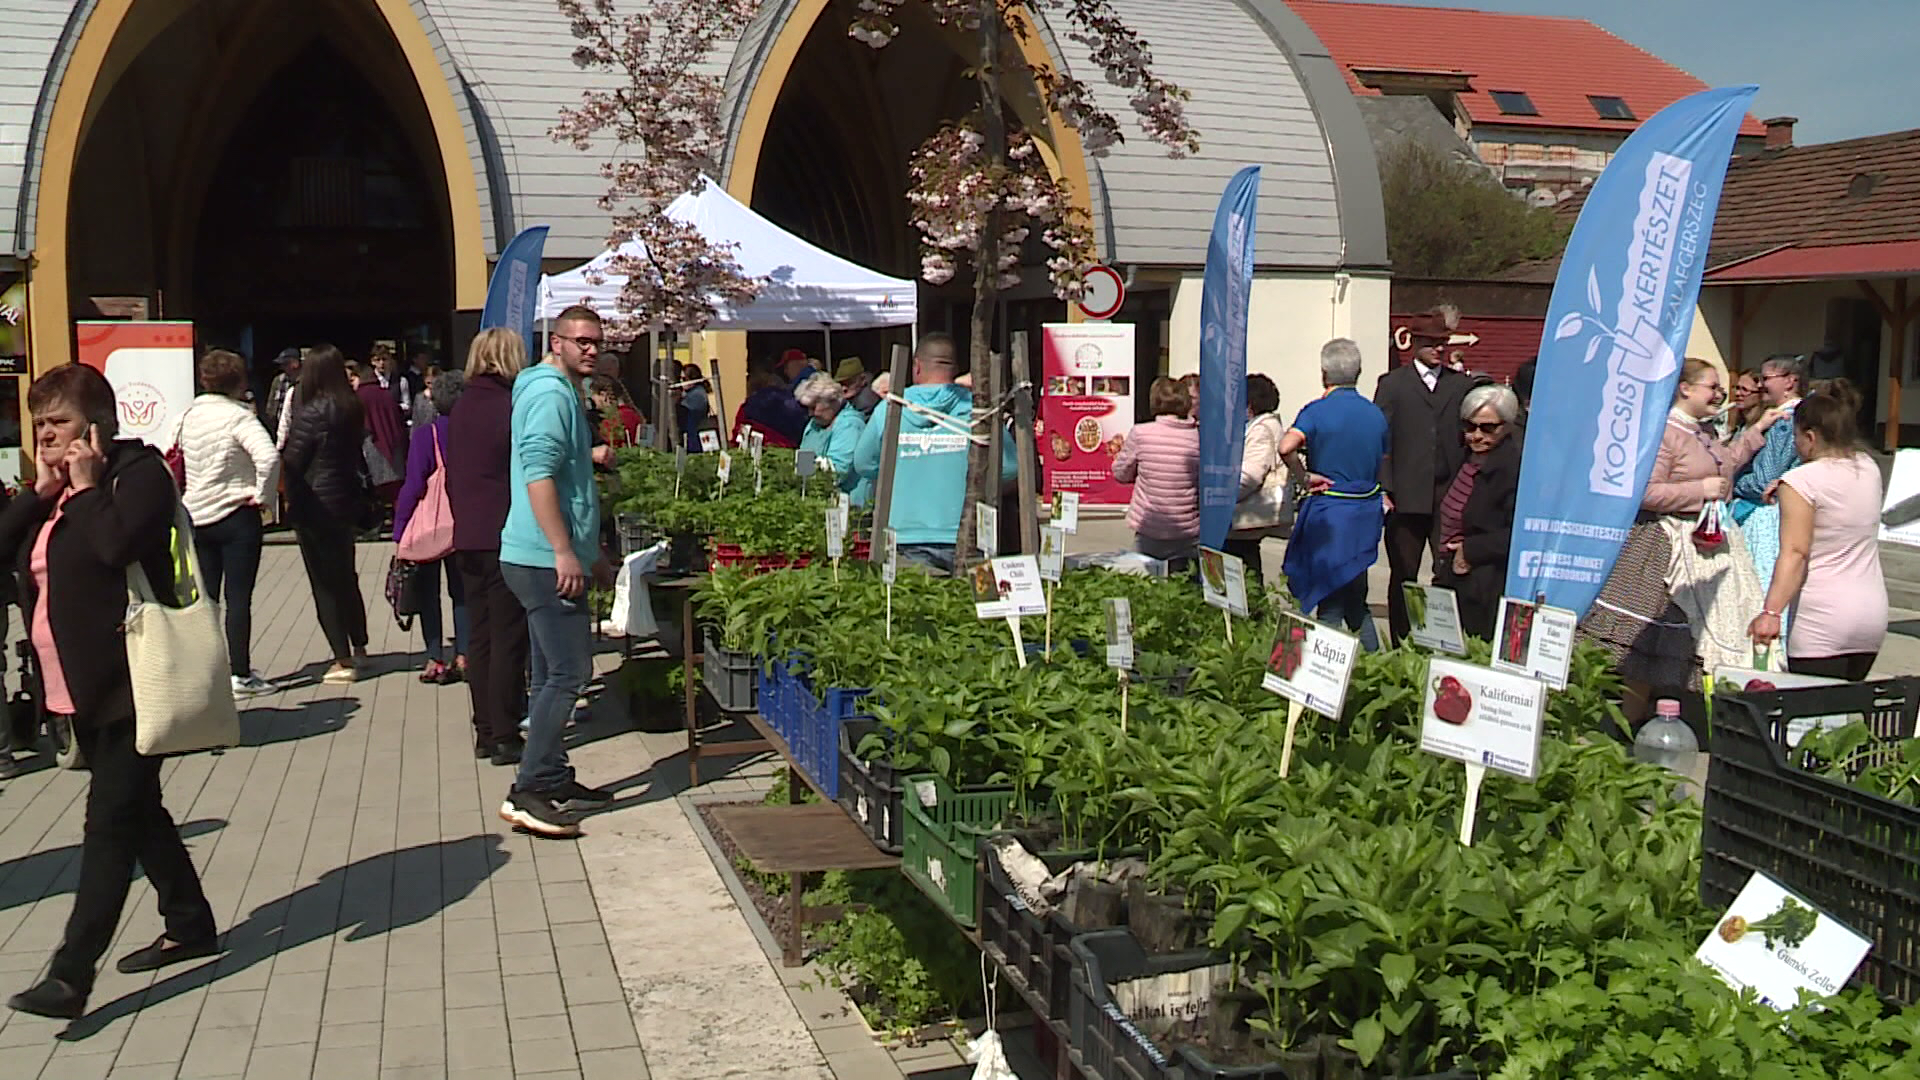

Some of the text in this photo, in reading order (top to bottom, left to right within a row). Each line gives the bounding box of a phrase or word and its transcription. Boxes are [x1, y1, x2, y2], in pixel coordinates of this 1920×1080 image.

[1665, 181, 1708, 326] ZALAEGERSZEG
[1602, 165, 1680, 487] KOCSIS KERTÉSZET
[1313, 638, 1347, 664] Kápia
[1480, 685, 1533, 707] Kaliforniai
[1777, 949, 1837, 993] Gumós Zeller
